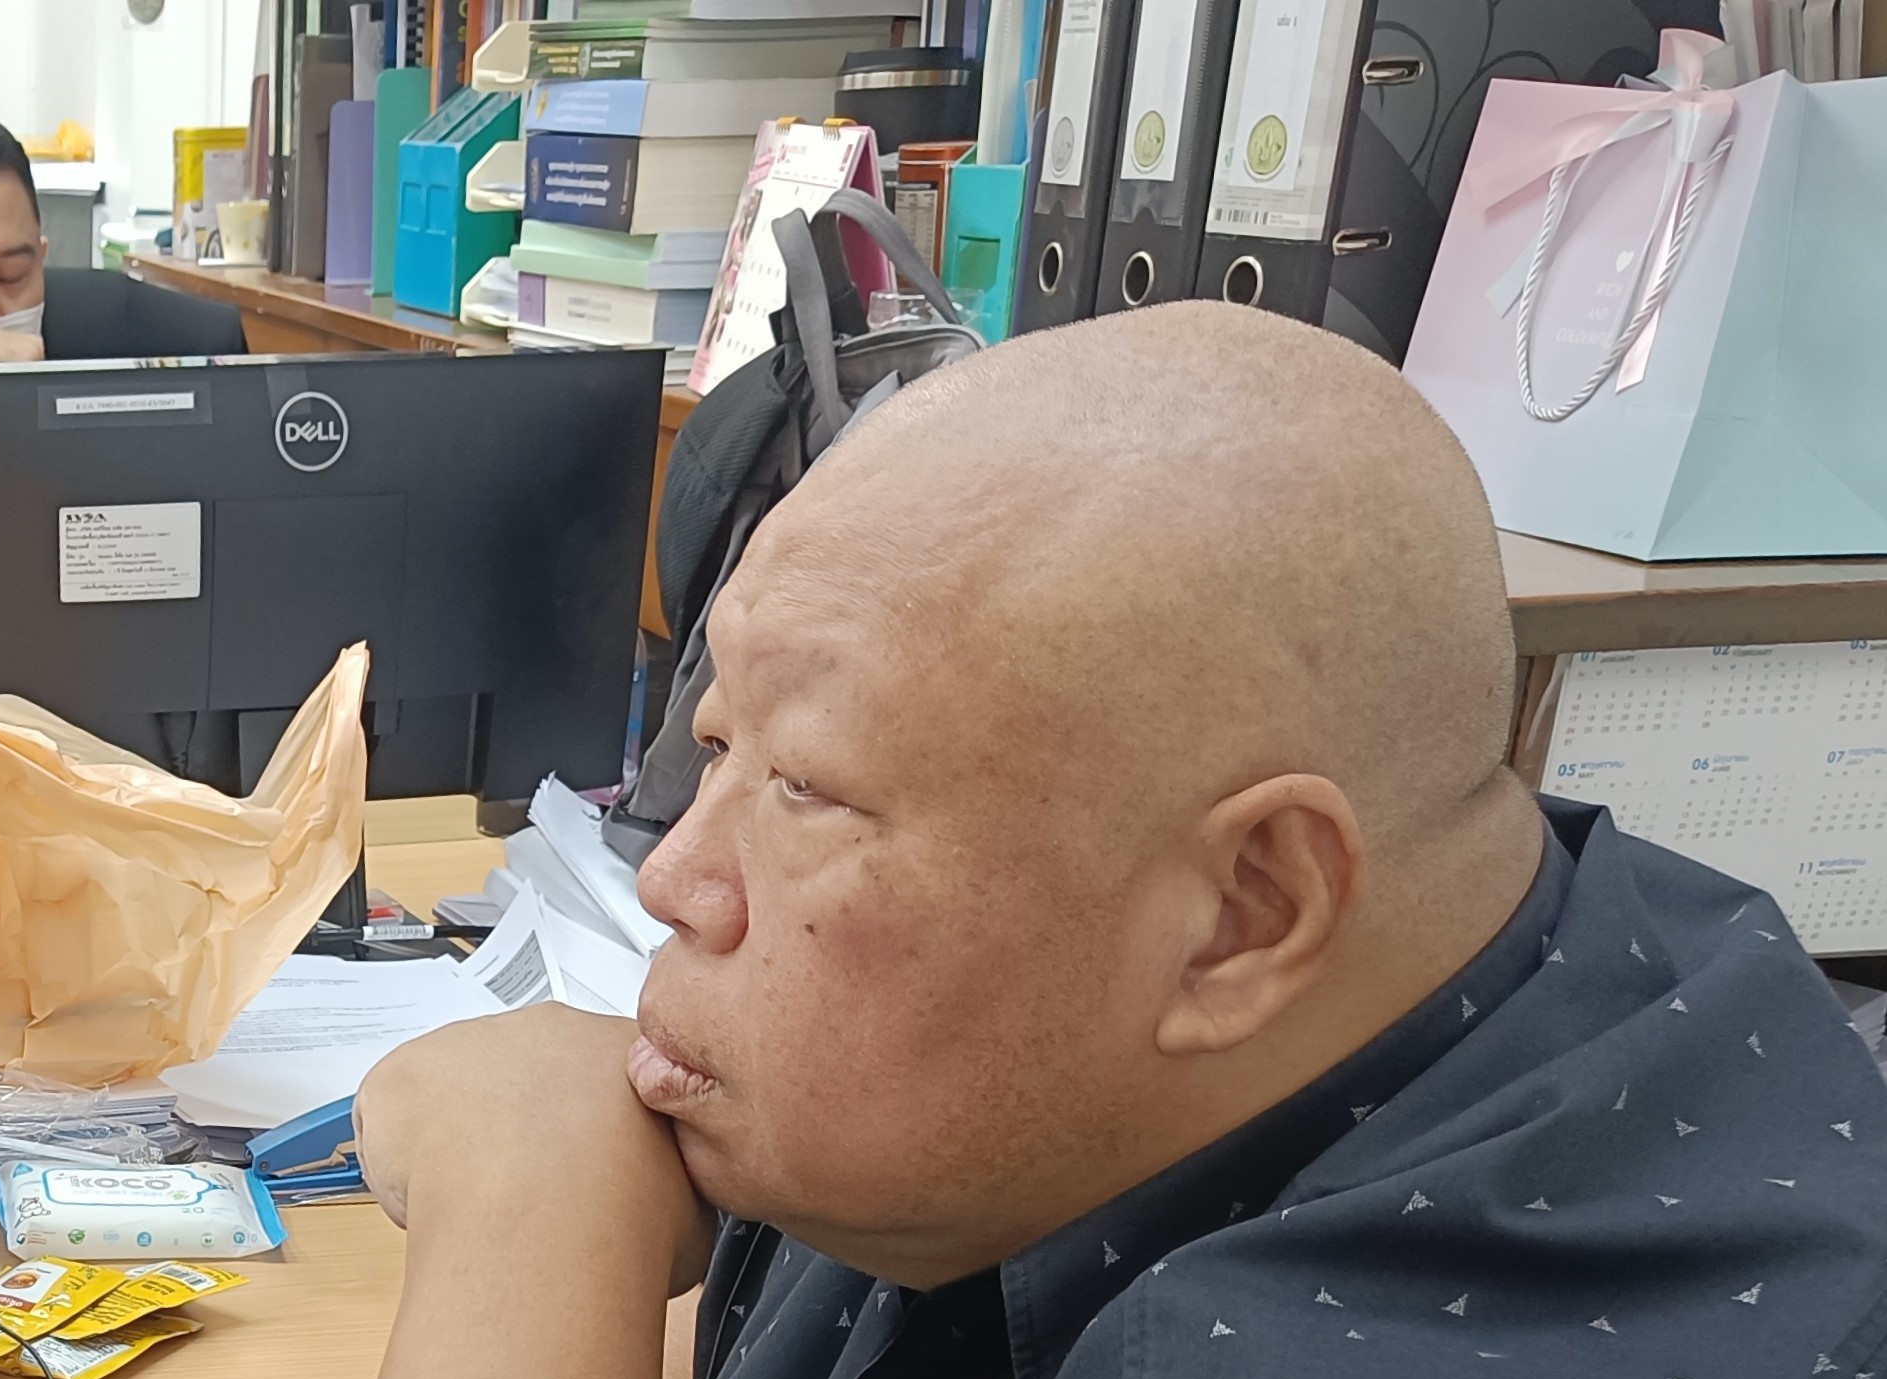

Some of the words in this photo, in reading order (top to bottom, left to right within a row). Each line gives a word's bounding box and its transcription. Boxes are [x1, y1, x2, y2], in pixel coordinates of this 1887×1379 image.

[285, 420, 341, 443] DELL
[1827, 751, 1845, 764] 07
[1557, 763, 1577, 777] 05
[1692, 758, 1710, 771] 06
[1798, 862, 1814, 874] 11
[182, 1206, 205, 1214] 20
